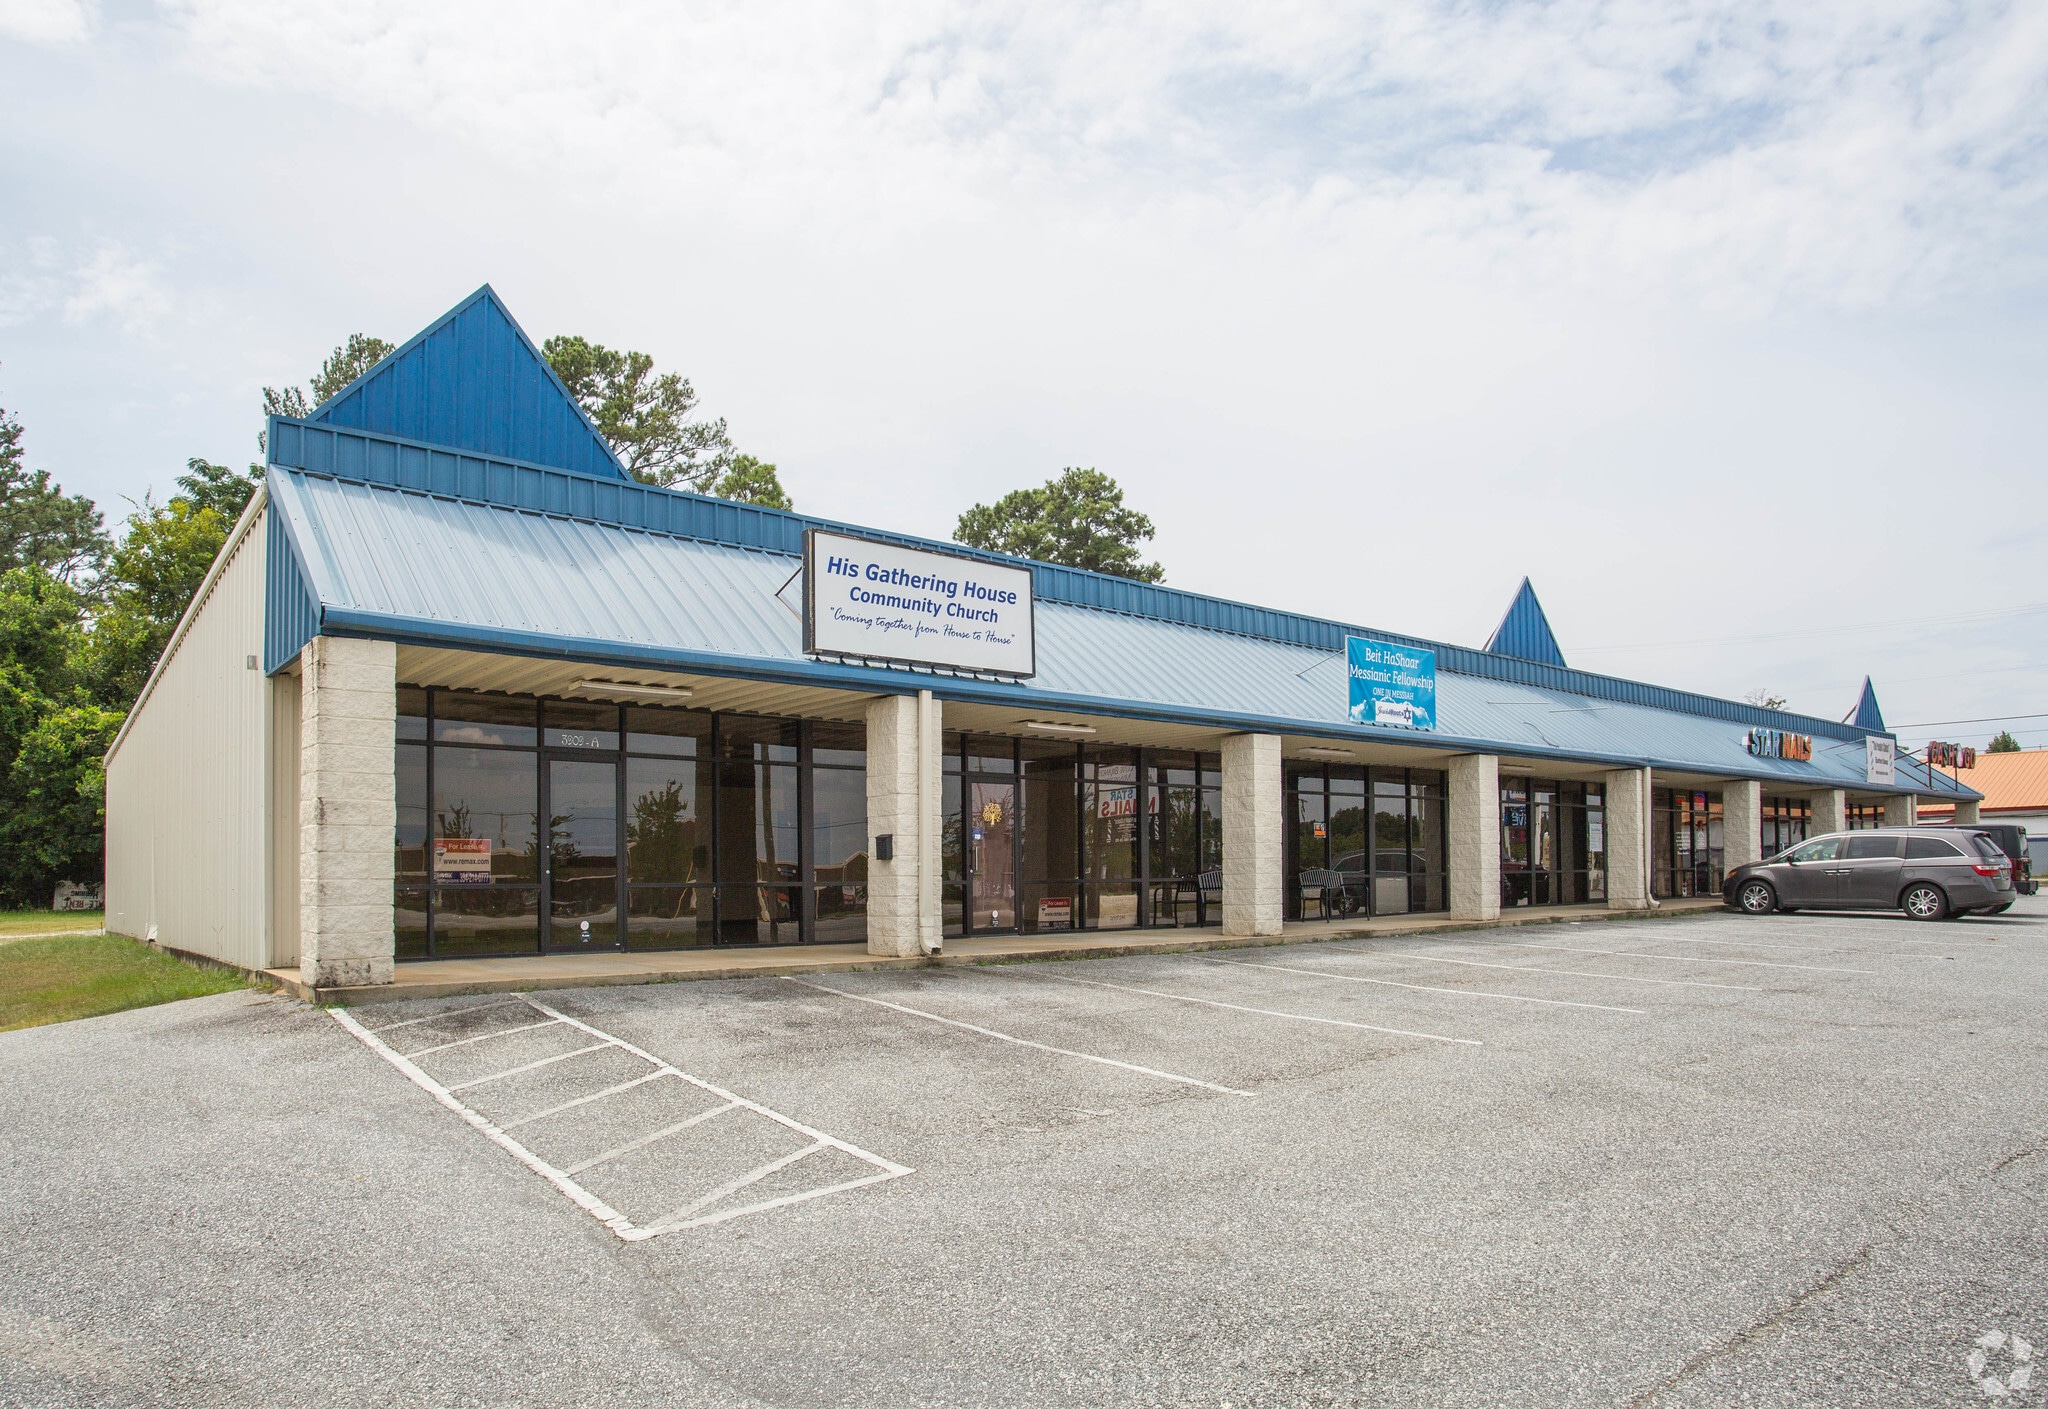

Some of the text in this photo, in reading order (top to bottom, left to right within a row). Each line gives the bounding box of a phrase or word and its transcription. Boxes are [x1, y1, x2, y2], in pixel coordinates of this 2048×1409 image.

[827, 556, 1017, 605] His Gathering House
[849, 586, 999, 623] Community Church
[876, 616, 913, 633] together
[915, 621, 939, 638] from
[943, 624, 971, 639] House
[972, 631, 981, 641] to
[1365, 647, 1420, 669] Beit HaShaar
[1349, 664, 1434, 693] Messianic Fellowship
[1751, 727, 1813, 761] STAR NAILS
[1931, 740, 1976, 769] CASH GO
